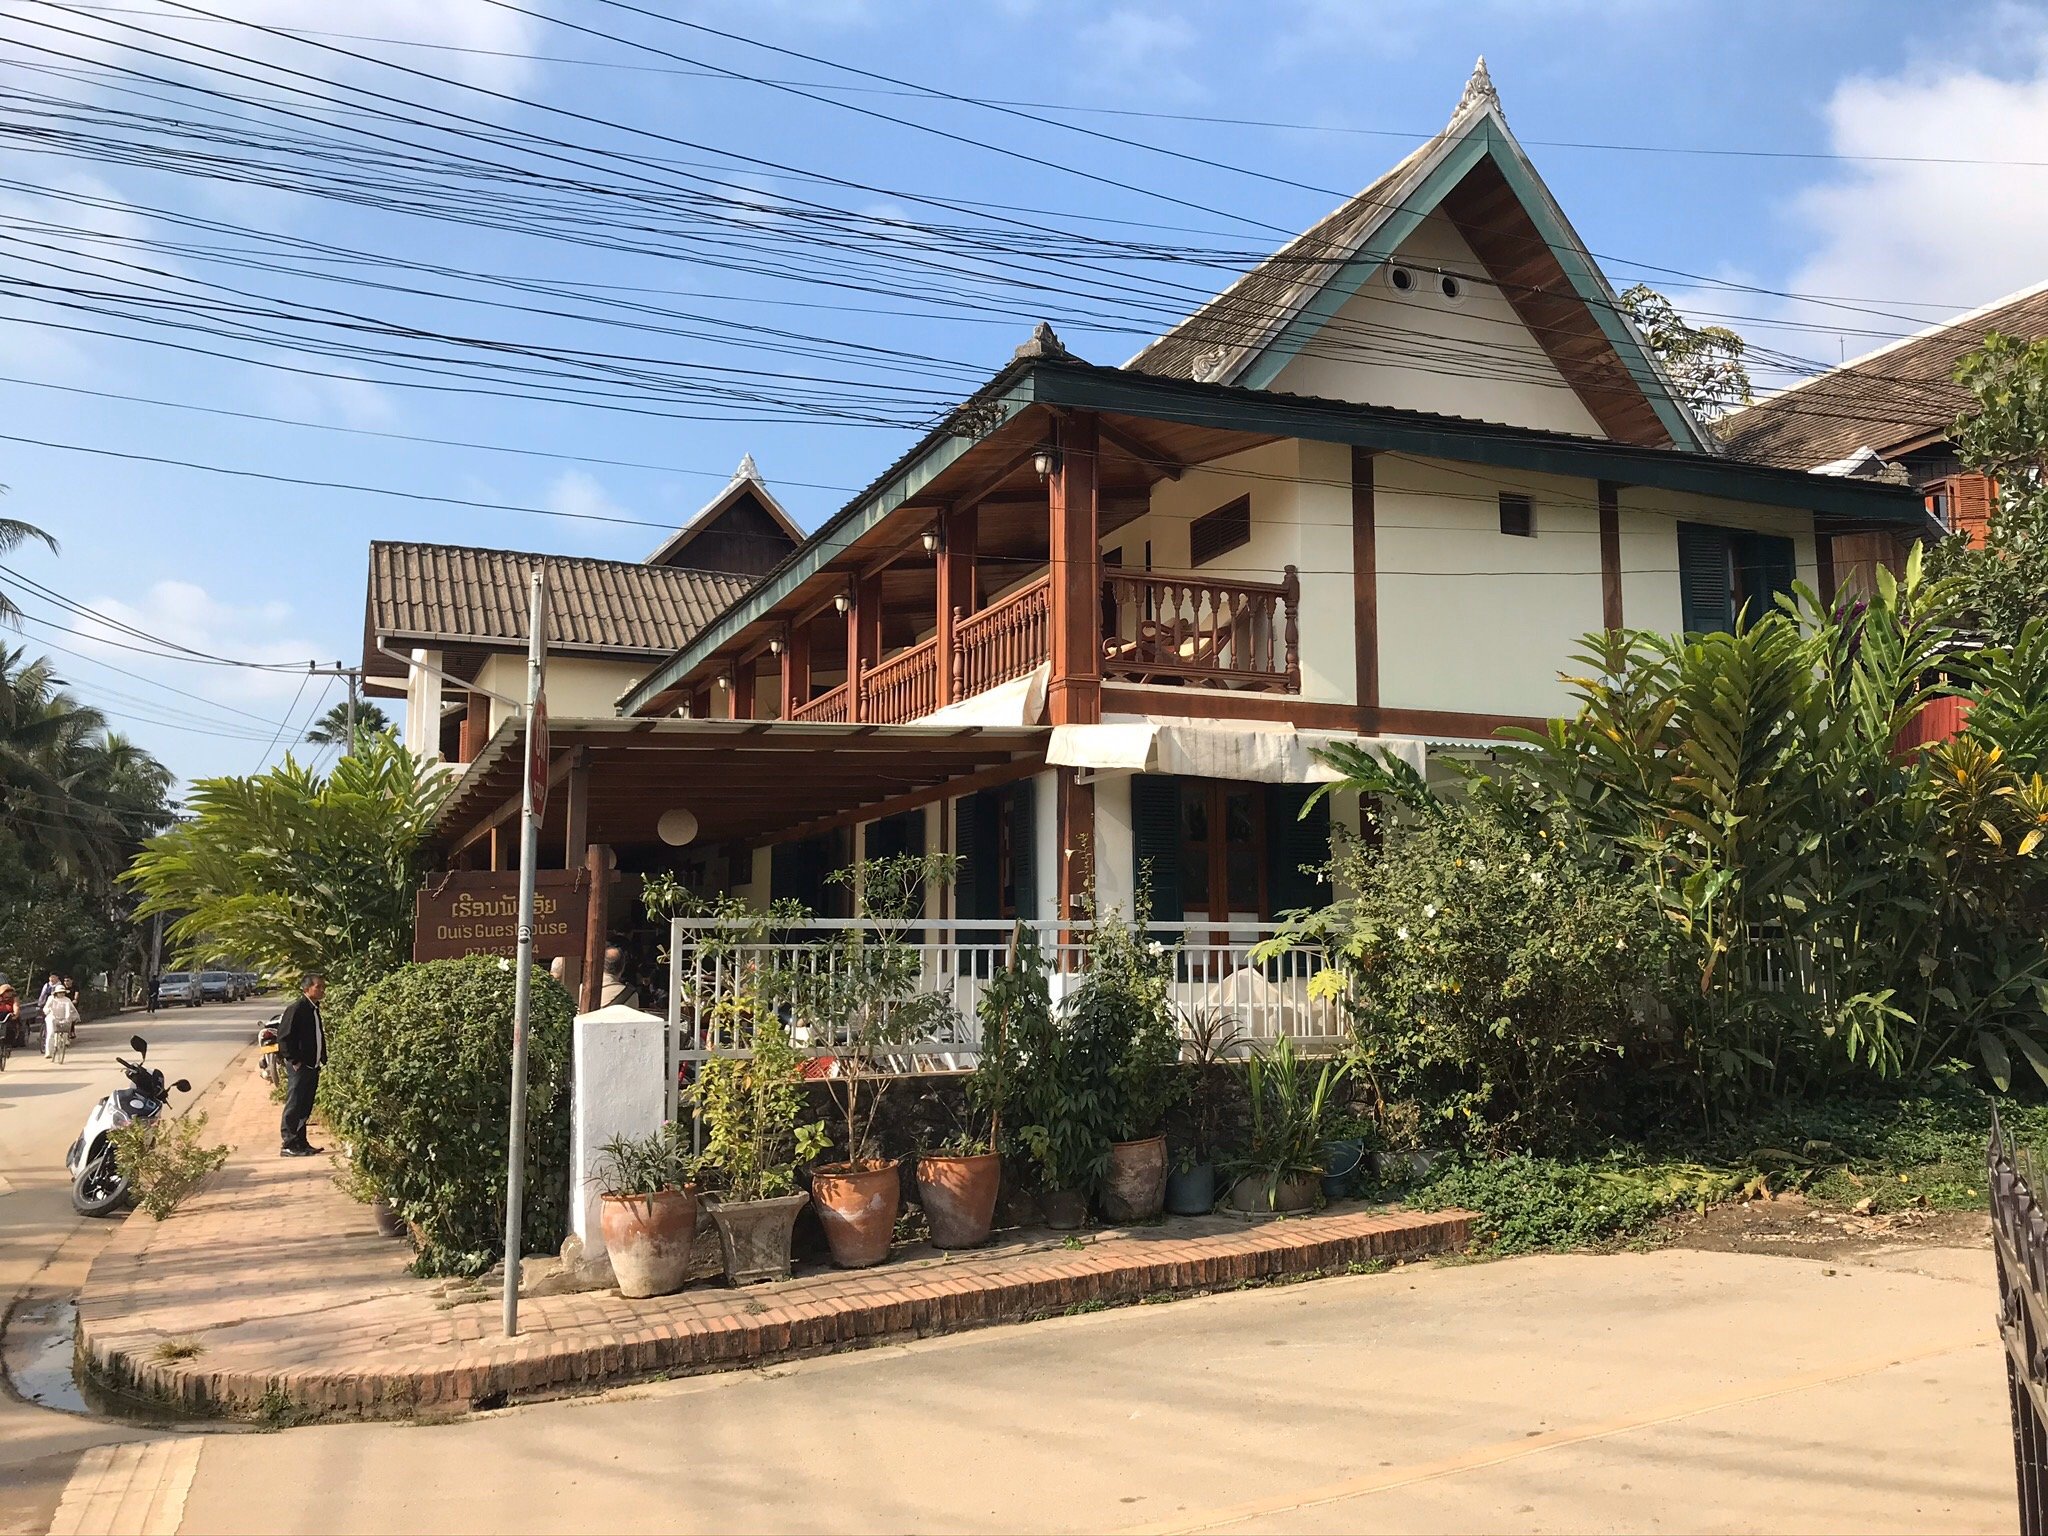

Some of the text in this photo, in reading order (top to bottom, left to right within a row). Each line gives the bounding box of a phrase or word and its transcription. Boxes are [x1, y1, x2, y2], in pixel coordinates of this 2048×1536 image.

[533, 780, 543, 801] STOP
[437, 924, 473, 940] Oui's
[475, 922, 568, 938] Guestouse
[491, 944, 540, 956] 2524
